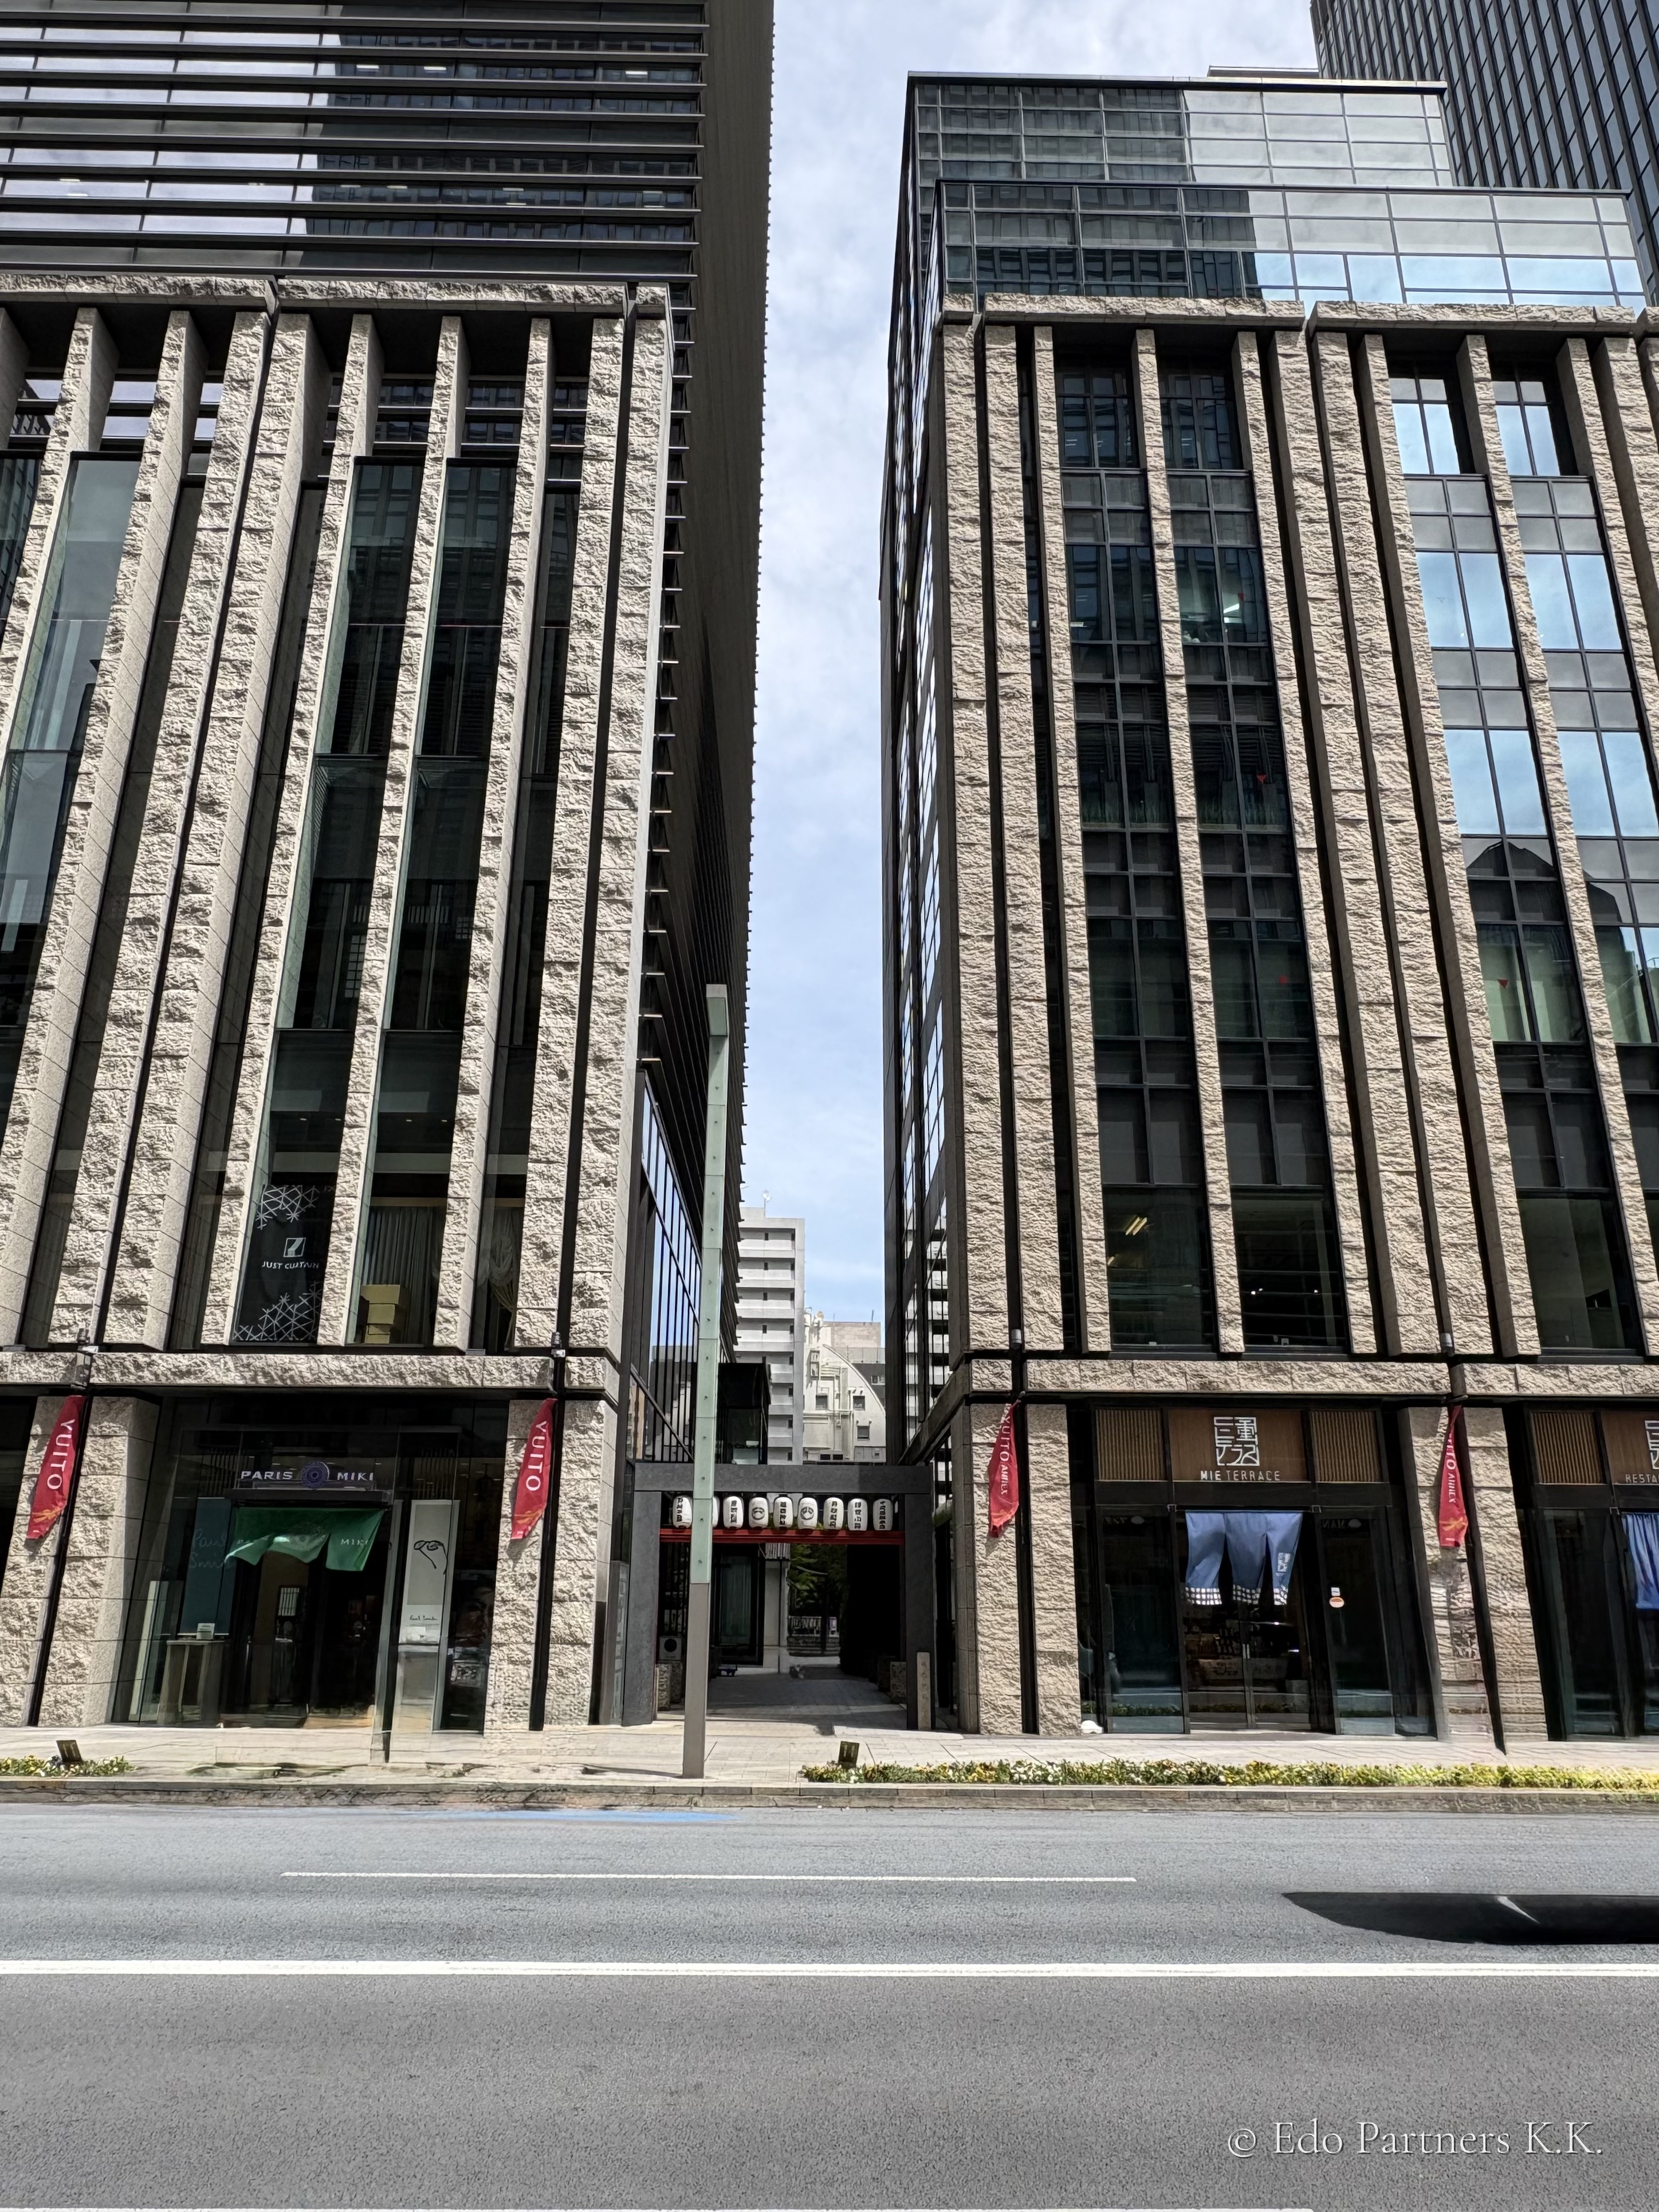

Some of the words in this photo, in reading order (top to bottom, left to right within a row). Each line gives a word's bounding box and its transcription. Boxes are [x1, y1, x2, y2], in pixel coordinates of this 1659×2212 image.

[262, 1261, 283, 1269] JUST
[999, 1416, 1011, 1462] YUITO
[47, 1419, 76, 1490] YUITO
[526, 1420, 547, 1491] YUITO
[241, 1471, 293, 1480] PARIS
[337, 1472, 374, 1481] MIKI
[1200, 1470, 1221, 1481] MIE
[1226, 1470, 1281, 1481] TERRACE
[1625, 1474, 1659, 1483] RESTA
